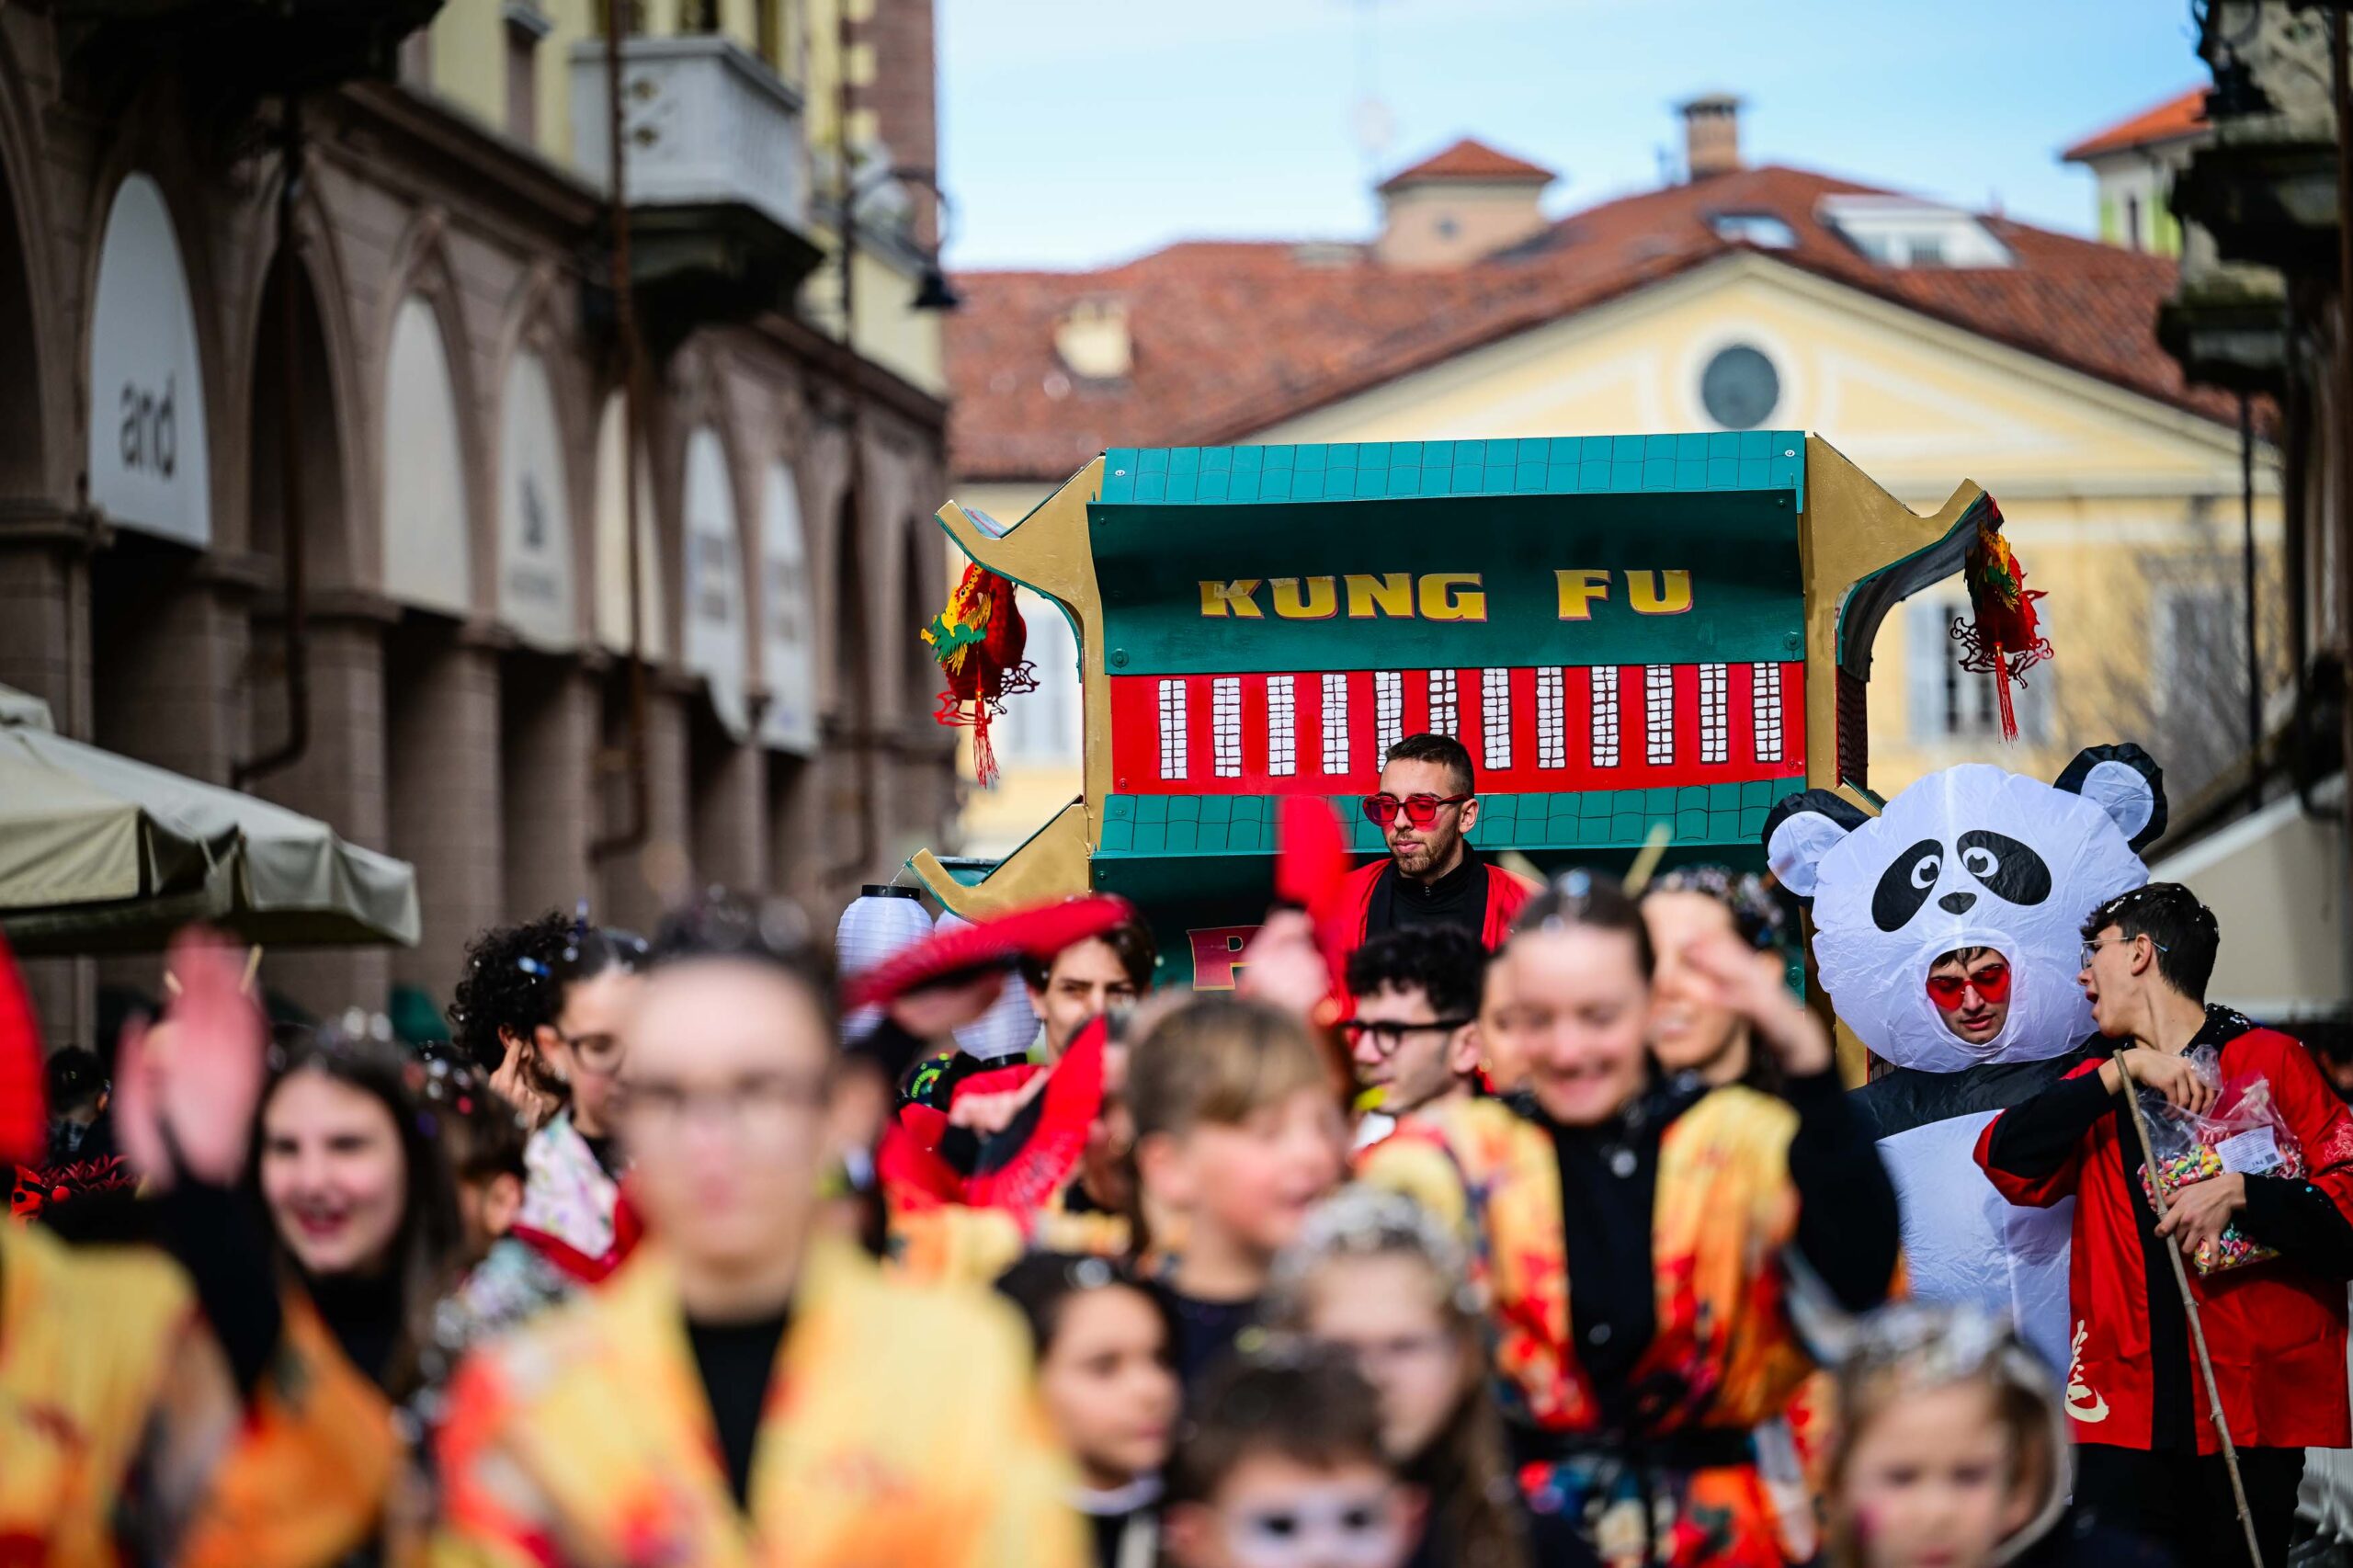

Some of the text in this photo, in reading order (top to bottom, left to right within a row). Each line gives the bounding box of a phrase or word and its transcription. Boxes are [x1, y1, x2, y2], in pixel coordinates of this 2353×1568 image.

[119, 372, 177, 483] and
[1198, 569, 1693, 622] KUNG FU
